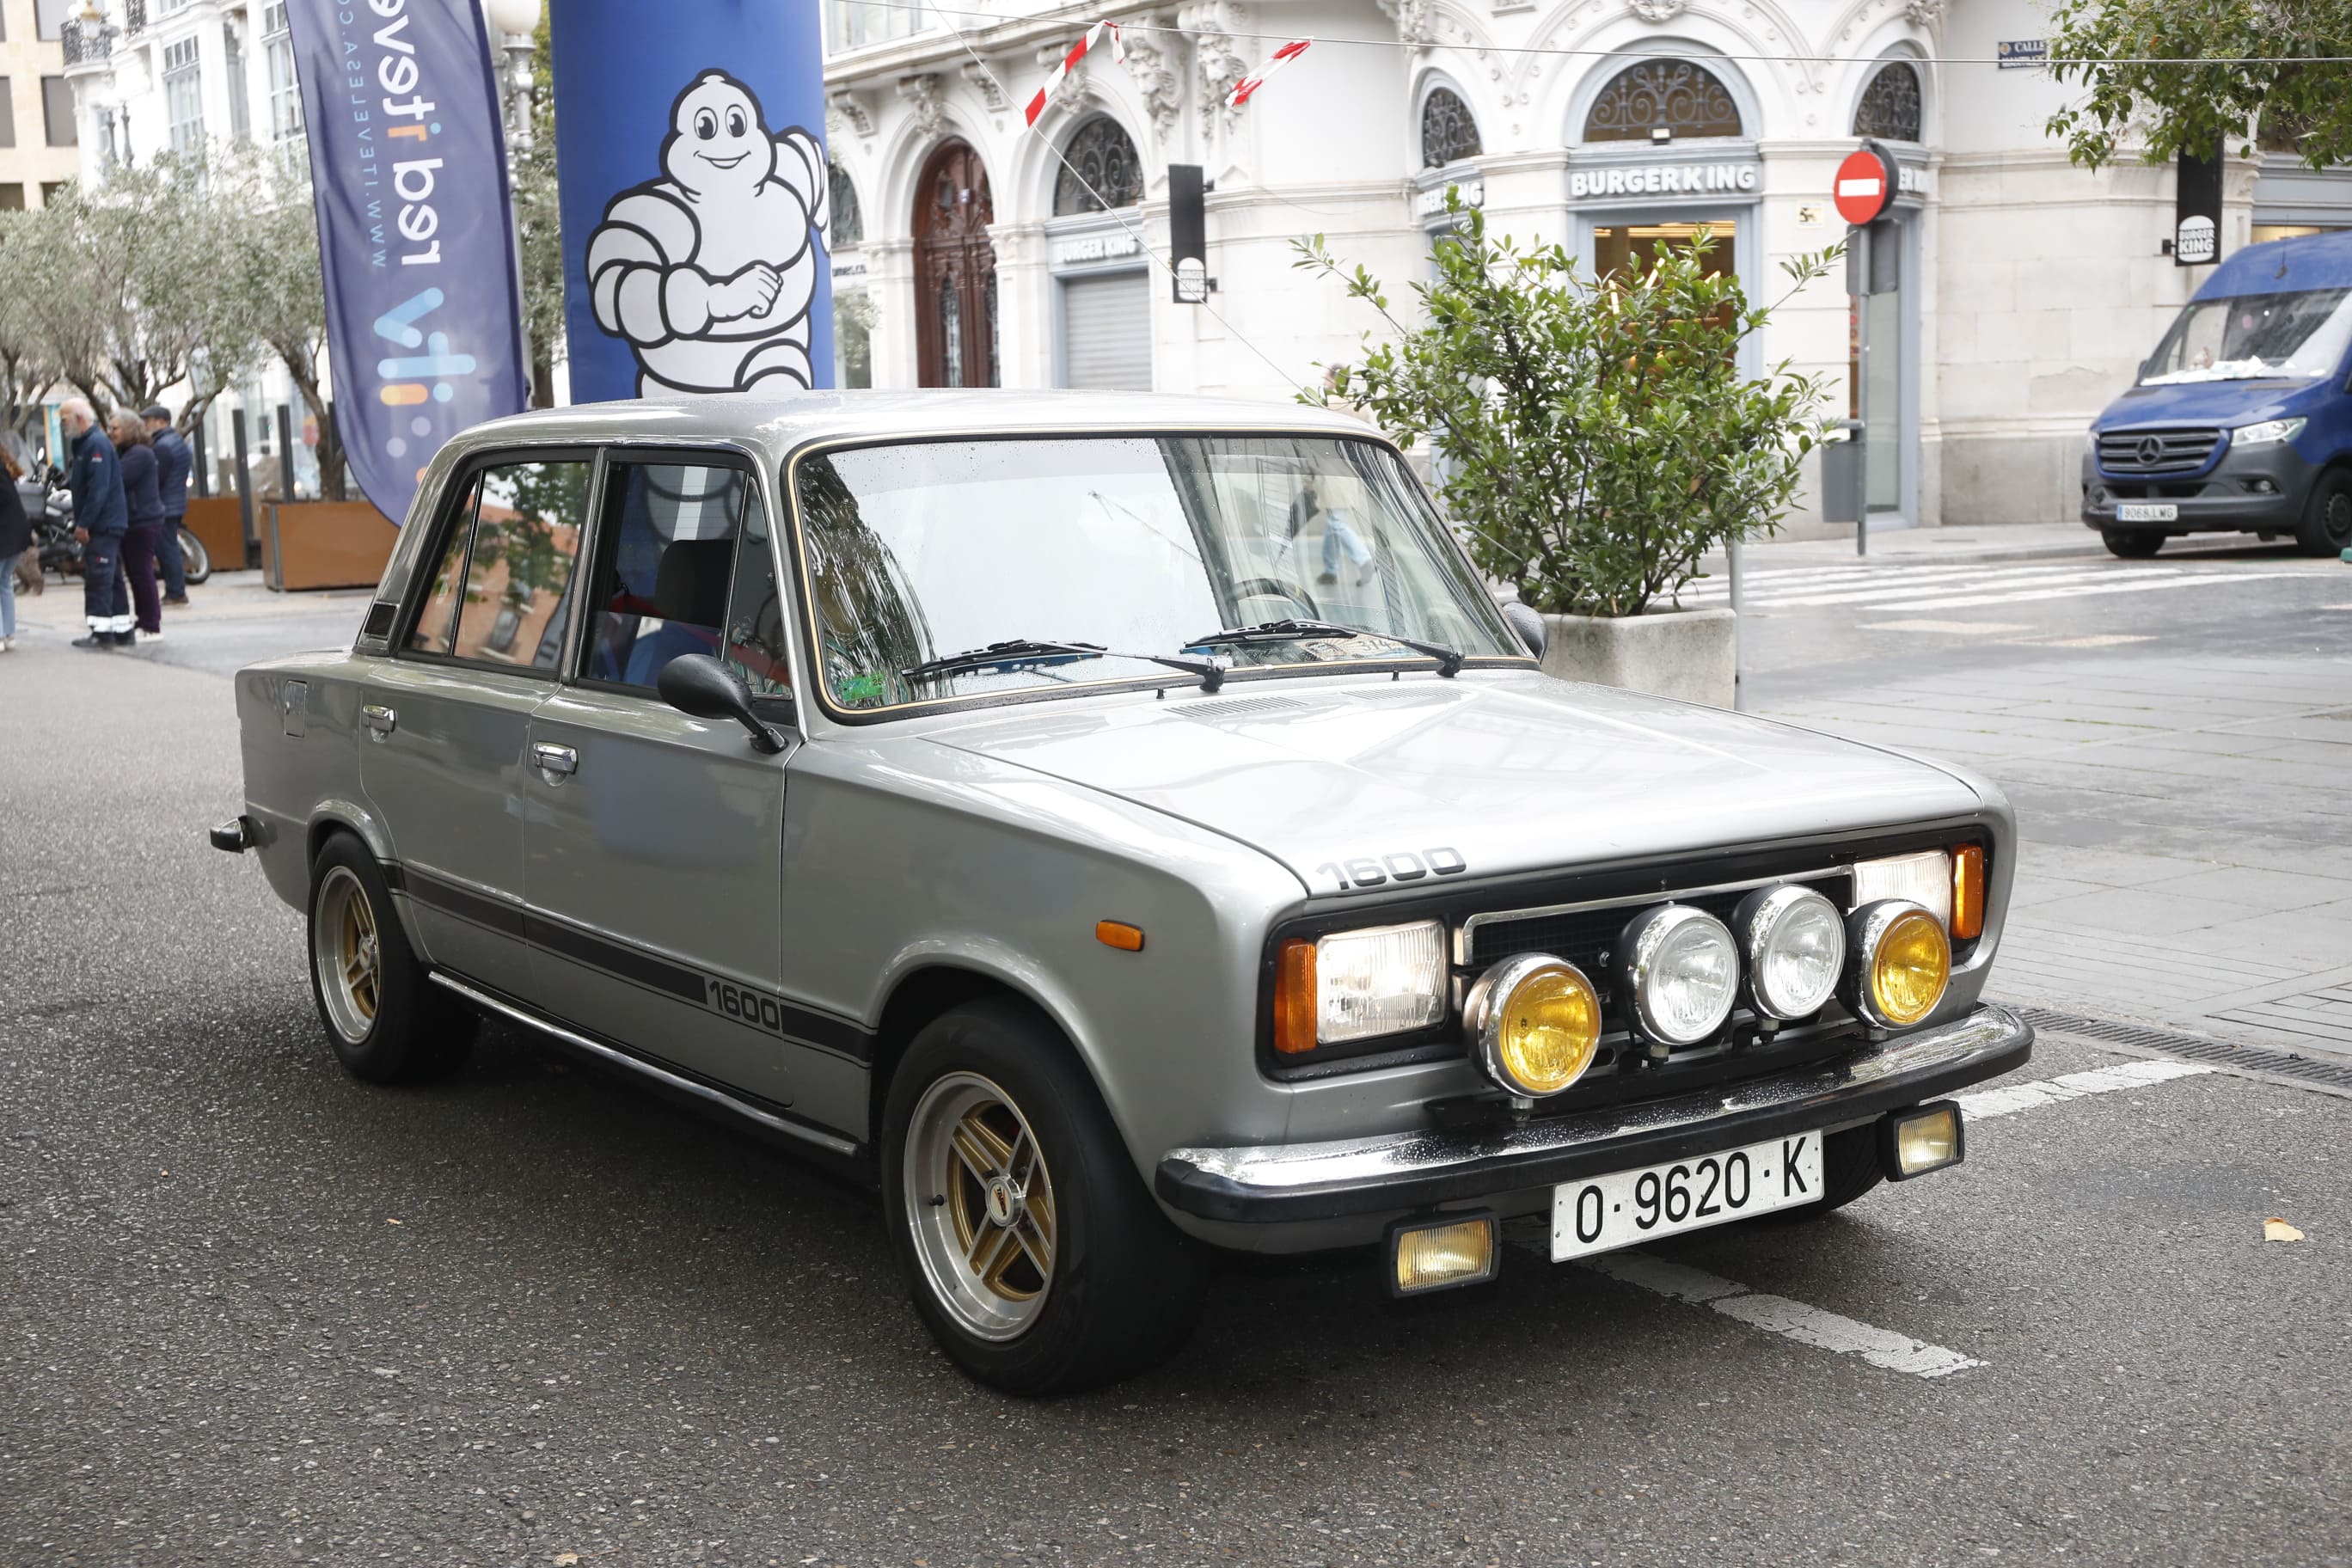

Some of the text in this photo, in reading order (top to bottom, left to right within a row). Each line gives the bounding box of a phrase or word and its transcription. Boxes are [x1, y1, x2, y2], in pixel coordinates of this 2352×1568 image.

[1571, 164, 1756, 197] BURGER KING
[2178, 238, 2214, 254] KING
[1315, 847, 1467, 891] 1600
[709, 980, 781, 1031] 1600
